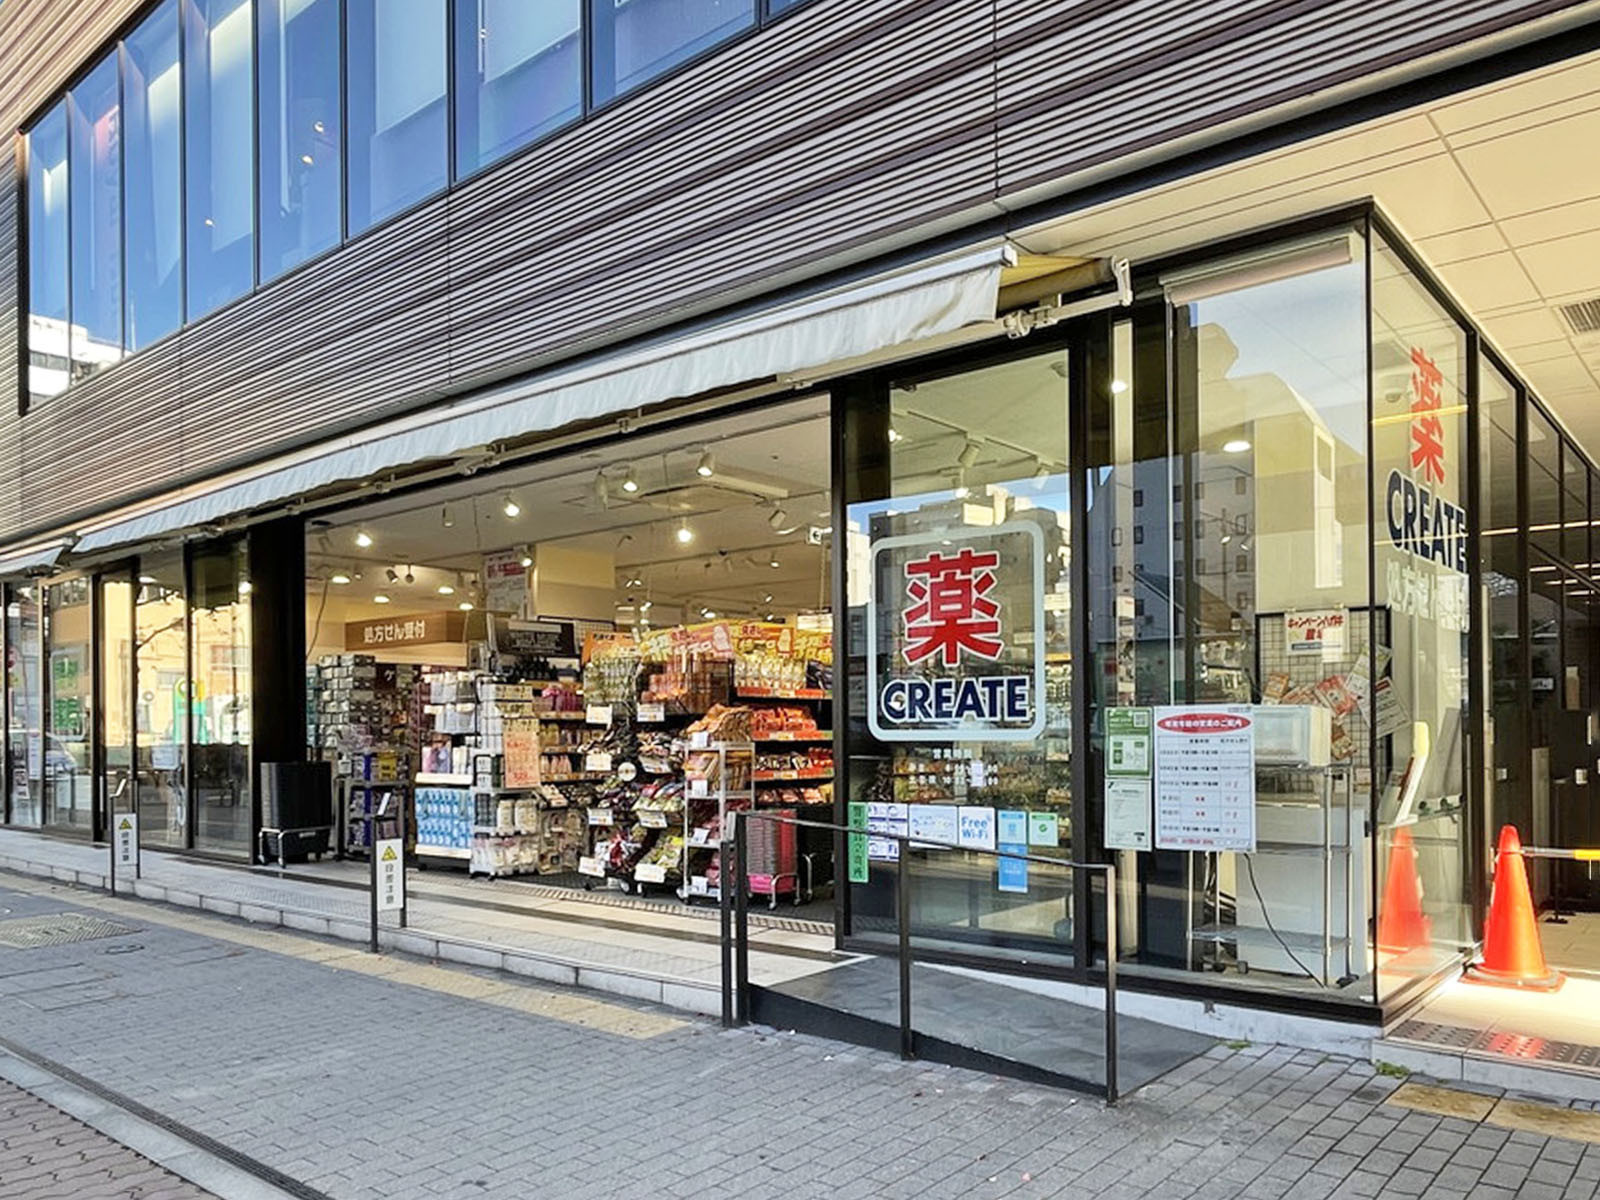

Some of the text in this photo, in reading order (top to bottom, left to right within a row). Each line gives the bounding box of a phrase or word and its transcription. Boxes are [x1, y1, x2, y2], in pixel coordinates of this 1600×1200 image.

[1386, 469, 1467, 574] CREATE
[903, 548, 1003, 666] 薬
[363, 619, 426, 644] 処方せん受付
[882, 676, 1029, 721] CREATE
[961, 815, 988, 829] Free
[961, 828, 989, 841] Wi-Fi
